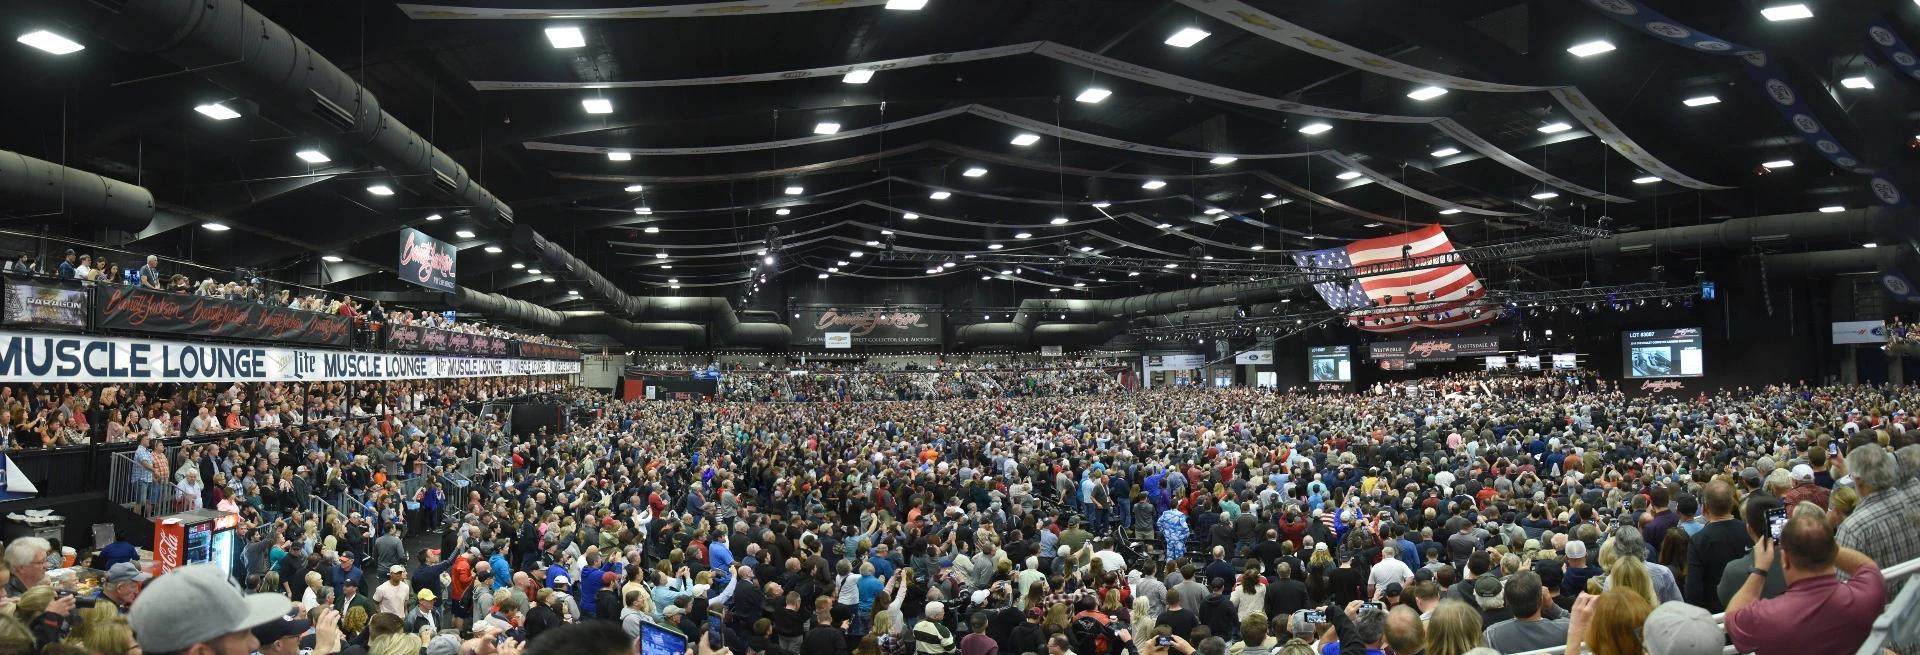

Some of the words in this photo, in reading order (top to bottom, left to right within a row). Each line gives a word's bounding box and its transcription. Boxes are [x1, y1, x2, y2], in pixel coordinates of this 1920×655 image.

[26, 296, 82, 309] PARAGON
[0, 336, 151, 379] MUSCLE
[163, 345, 267, 379] LOUNGE
[294, 351, 316, 379] Lite
[324, 353, 382, 378] MUSCLE
[385, 356, 428, 377] LOUNGE
[448, 359, 478, 376] MUSCLE
[479, 360, 503, 375] LOUNGE
